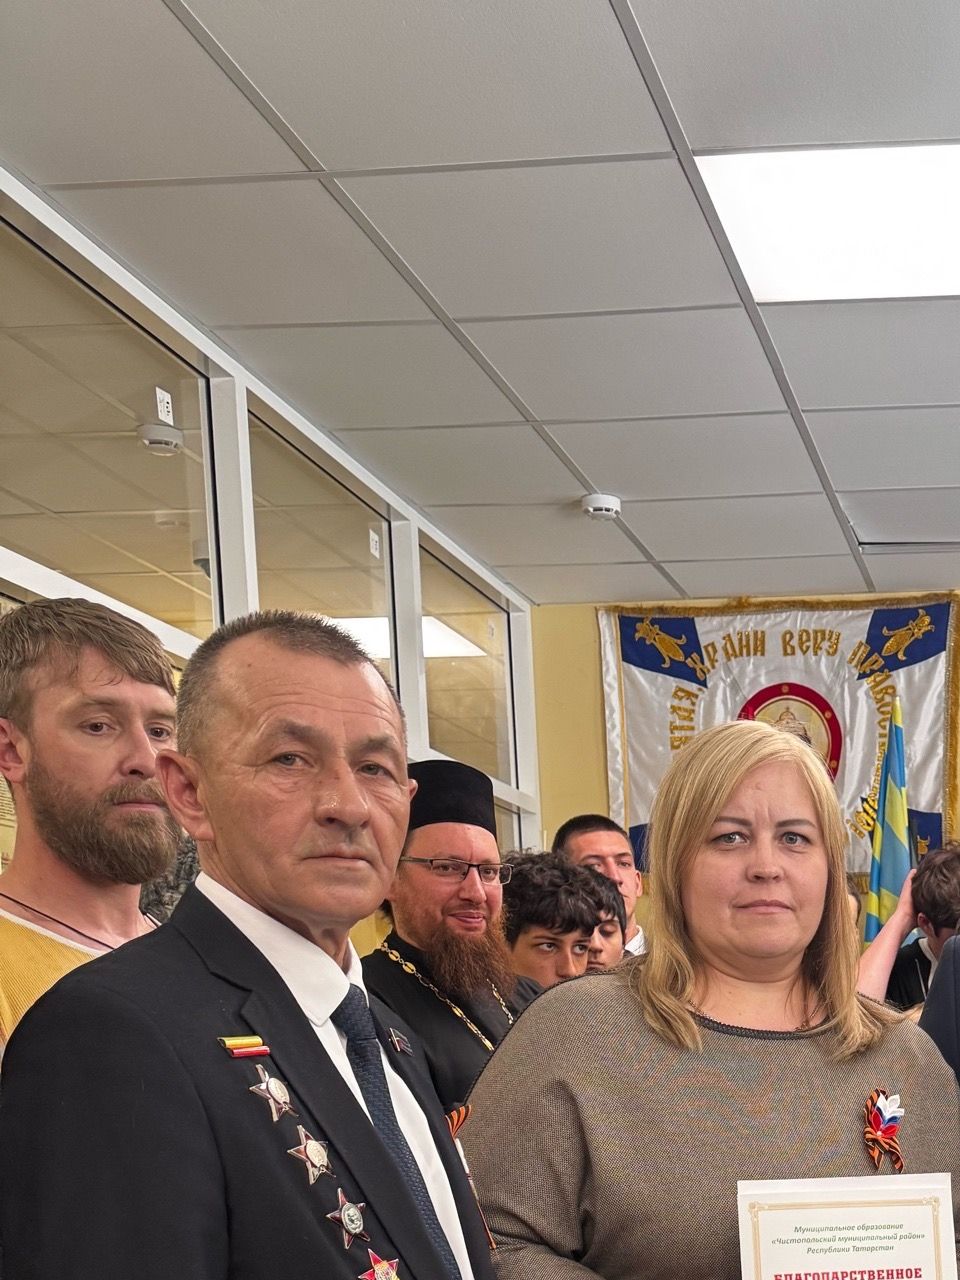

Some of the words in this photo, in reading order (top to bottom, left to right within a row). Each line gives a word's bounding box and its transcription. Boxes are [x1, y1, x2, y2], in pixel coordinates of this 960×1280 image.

[793, 1225, 855, 1234] Муниципальное
[857, 1223, 904, 1231] образование
[838, 1233, 898, 1243] муниципальный
[806, 1246, 851, 1255] Республики
[852, 1245, 895, 1253] Татарстан
